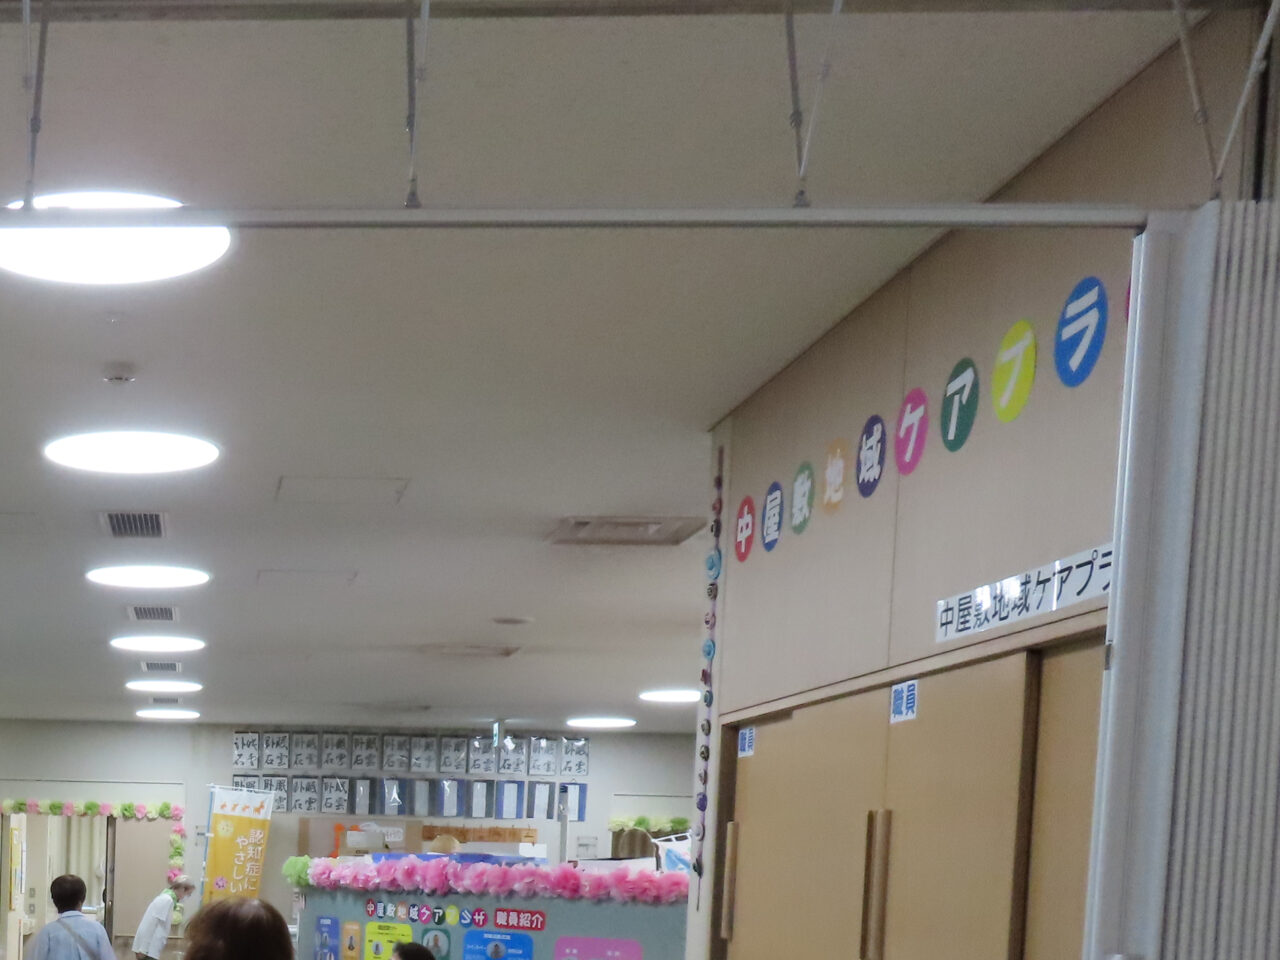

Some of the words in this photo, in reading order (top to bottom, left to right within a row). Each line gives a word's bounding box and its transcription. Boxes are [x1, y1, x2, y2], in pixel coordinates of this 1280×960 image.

[230, 836, 248, 893] やさしい
[244, 828, 264, 890] 認知症に
[496, 910, 544, 929] 職員紹介
